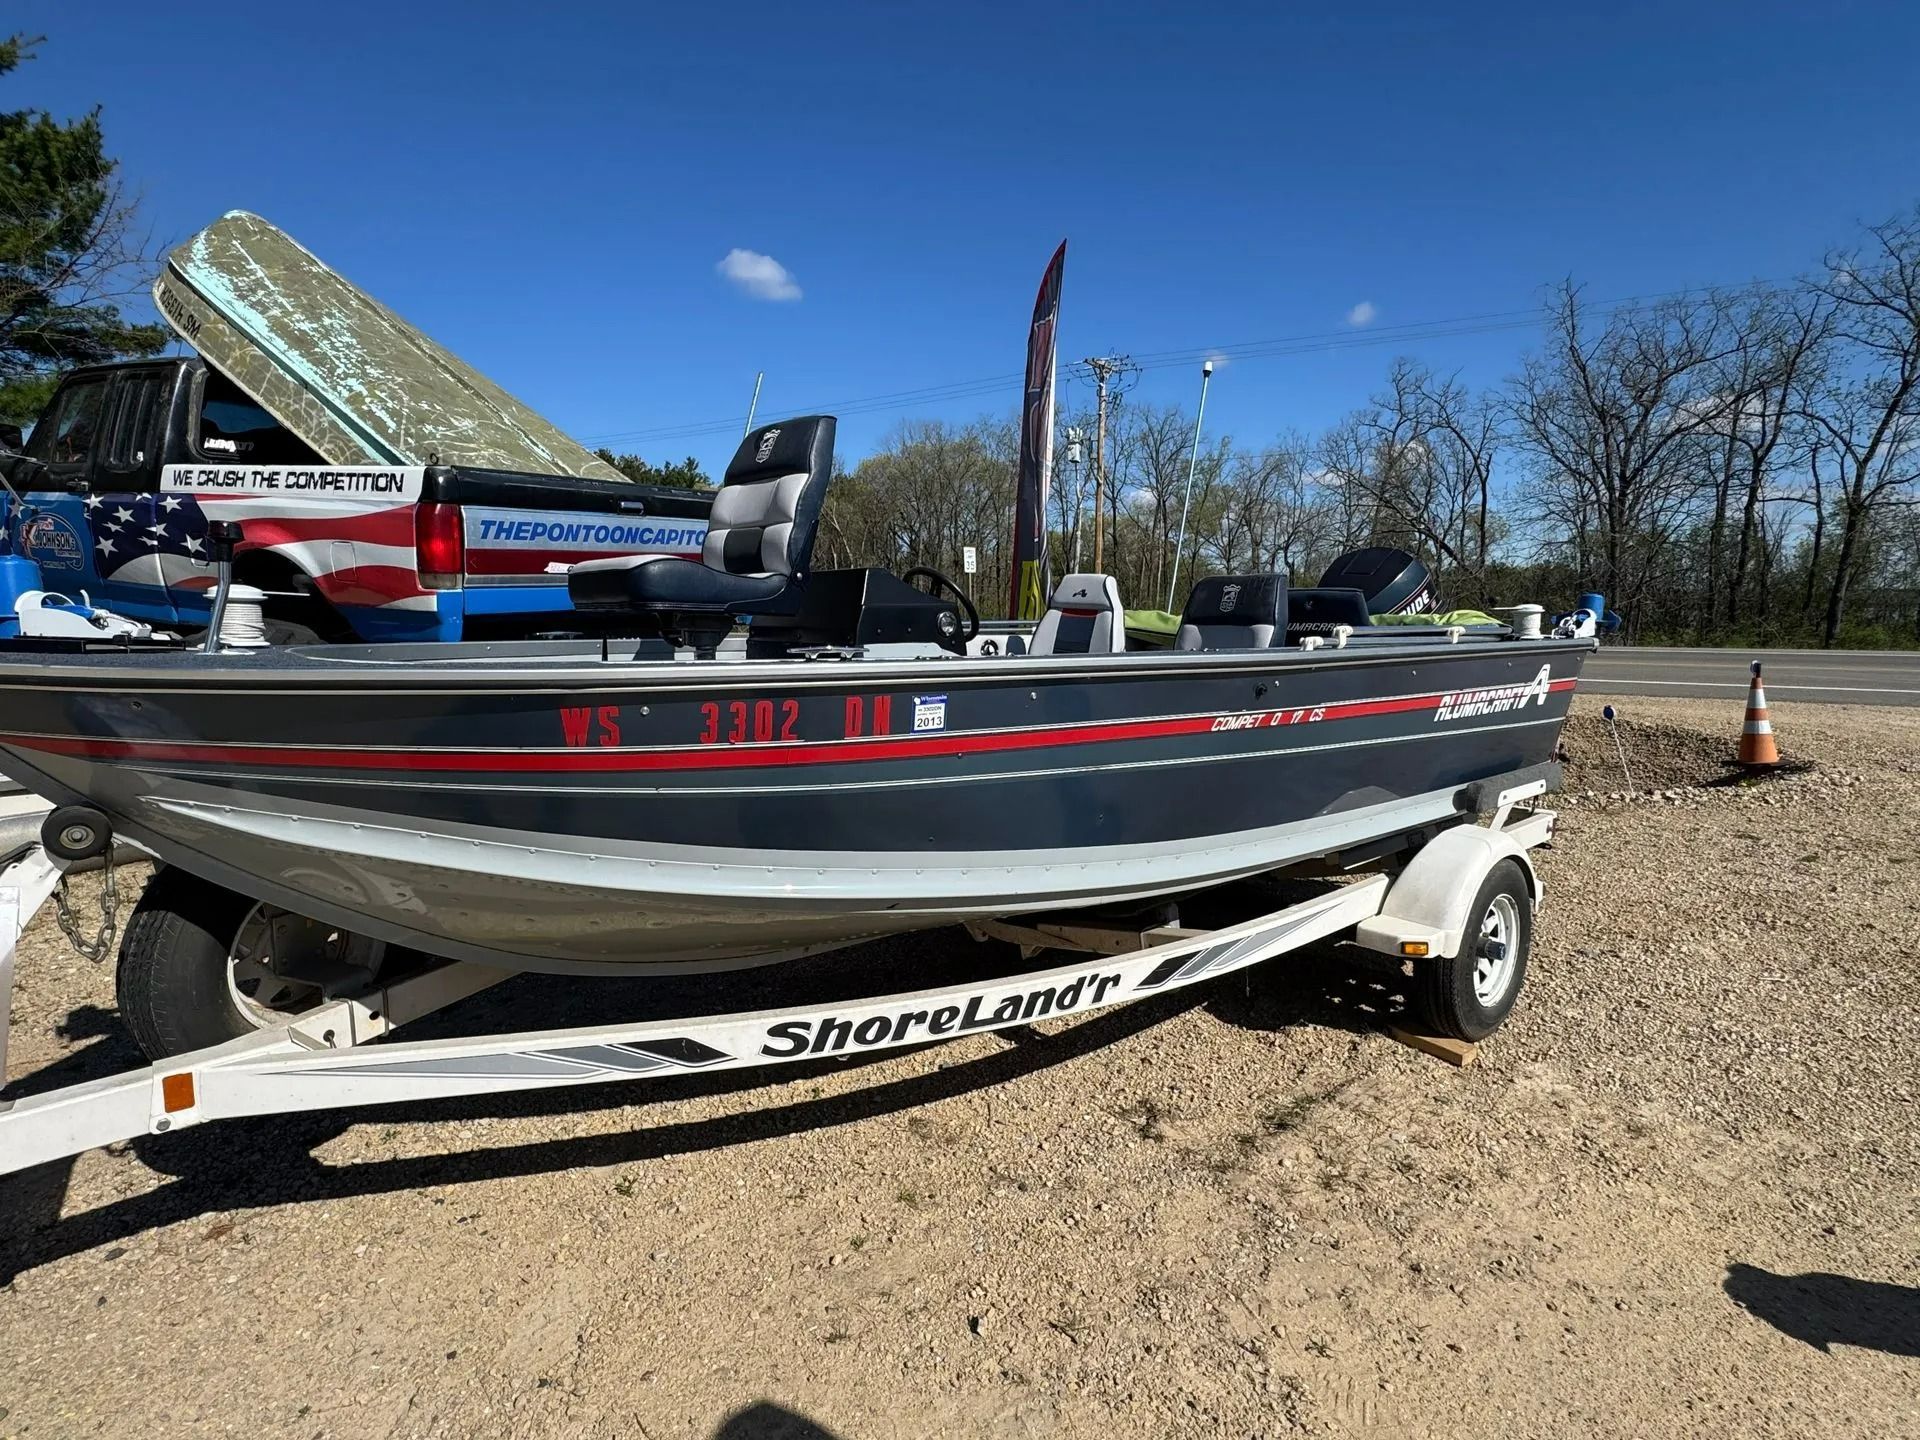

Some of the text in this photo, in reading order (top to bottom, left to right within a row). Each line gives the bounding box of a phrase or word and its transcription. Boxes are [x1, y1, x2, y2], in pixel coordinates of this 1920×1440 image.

[183, 314, 201, 341] WS
[173, 470, 405, 493] WE CRUSH THE COMPETITION
[1434, 685, 1528, 722] ALUMACRAFT
[560, 694, 892, 748] WS 3302 DN
[917, 716, 943, 728] 2013
[1211, 714, 1266, 732] COMPET
[1290, 710, 1304, 724] 17
[1309, 708, 1326, 722] CS
[760, 973, 1122, 1058] ShoreLand'r
